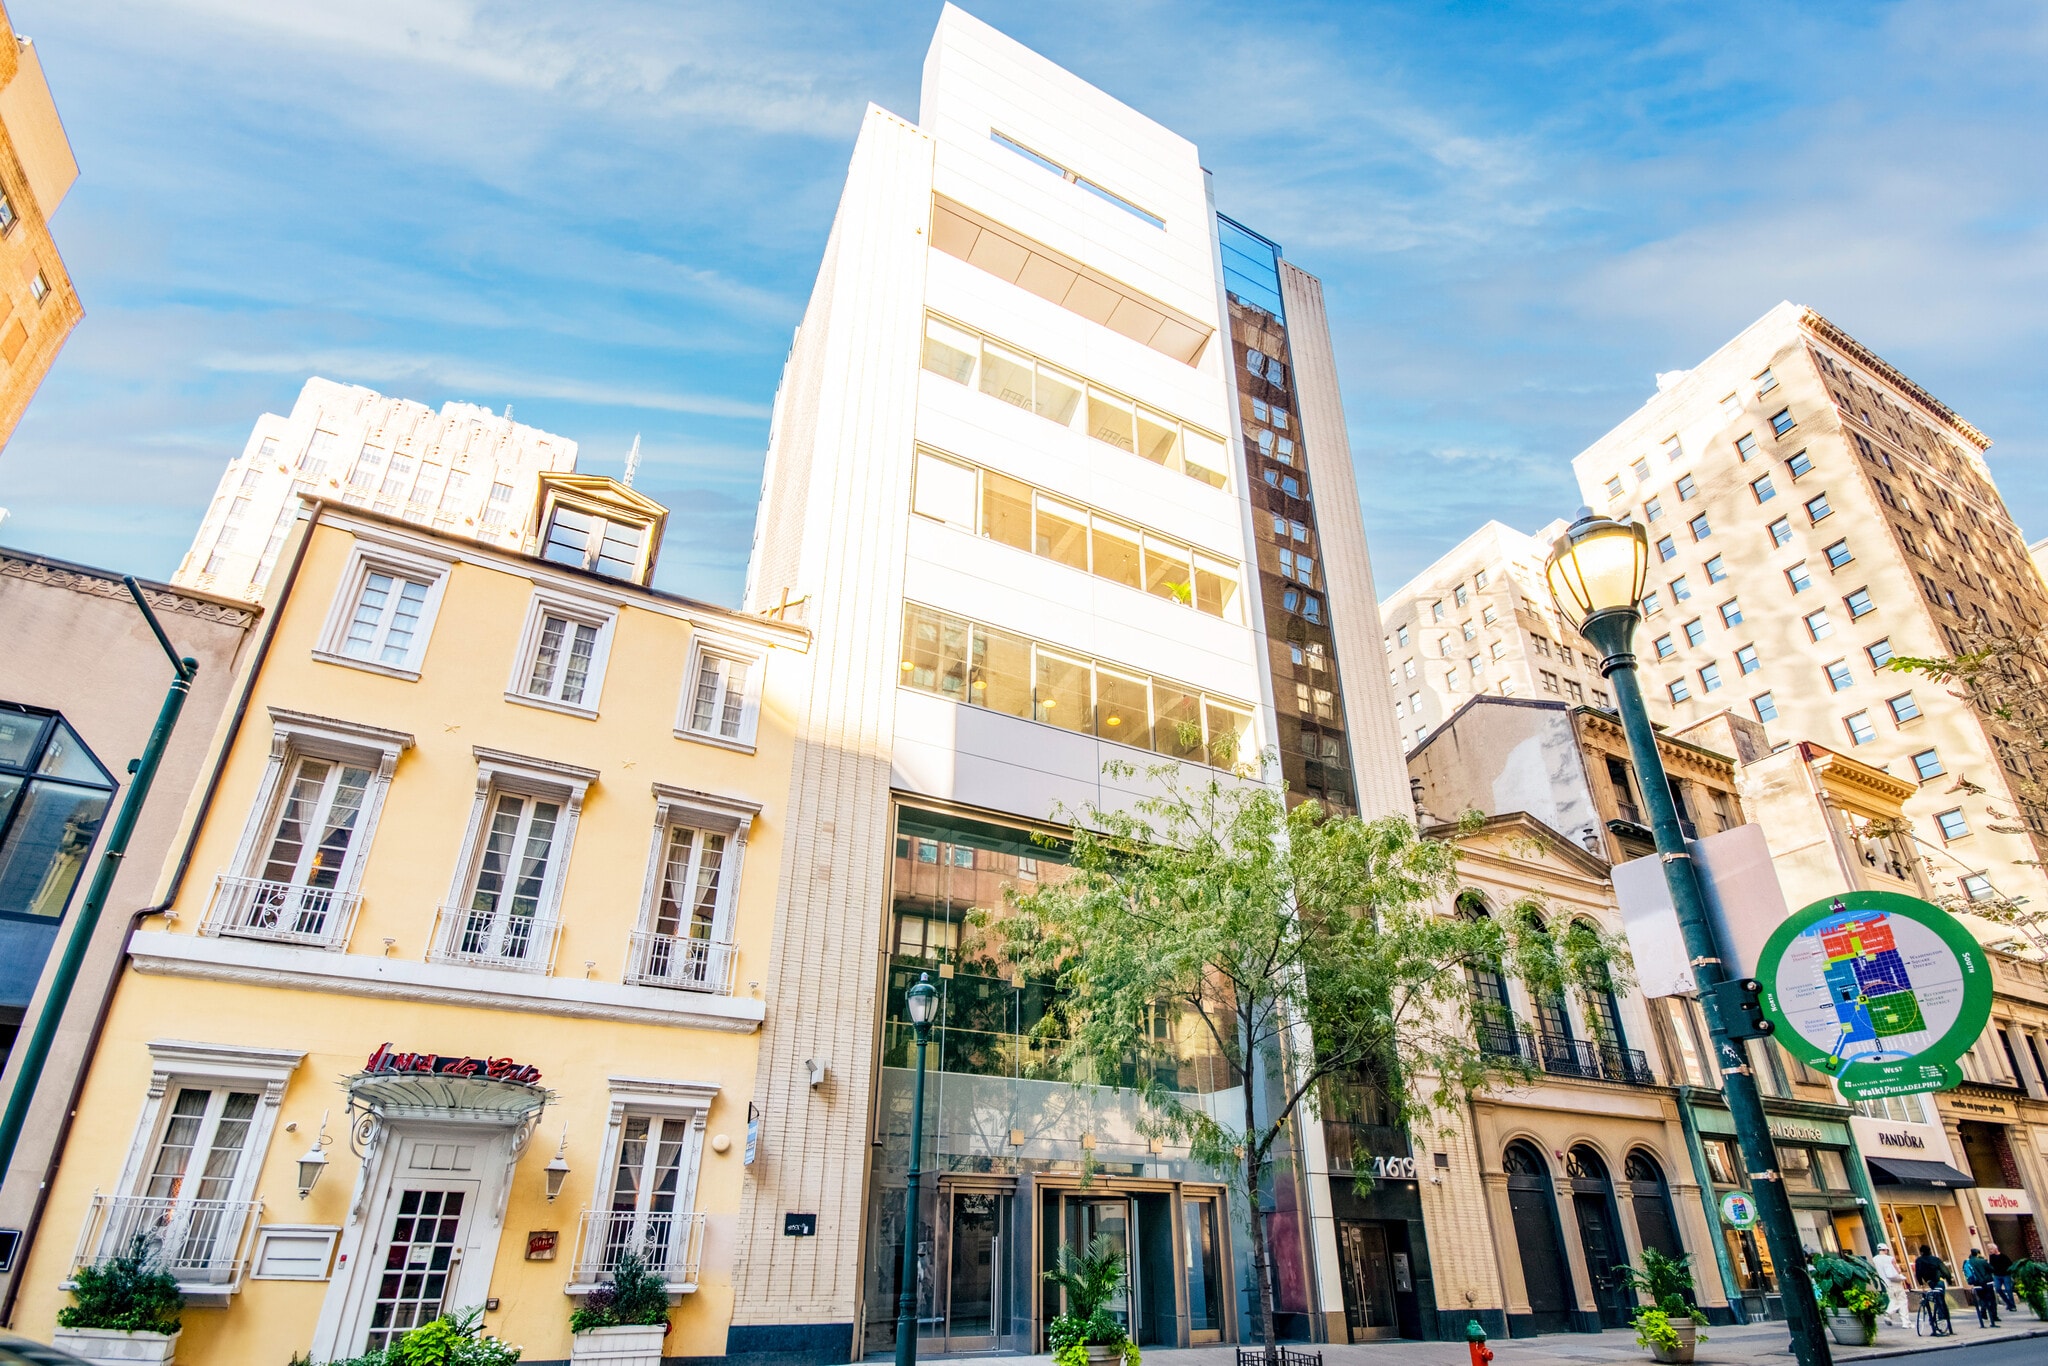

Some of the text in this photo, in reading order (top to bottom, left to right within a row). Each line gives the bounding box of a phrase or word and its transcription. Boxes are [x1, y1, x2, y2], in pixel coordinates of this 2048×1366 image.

[1829, 902, 1846, 911] EAST
[1767, 993, 1778, 1012] NORTH
[442, 1056, 478, 1076] de
[1883, 1066, 1903, 1074] WEST
[1778, 1122, 1822, 1140] balance
[1878, 1131, 1925, 1149] PANDORA
[1374, 1156, 1415, 1178] 1619
